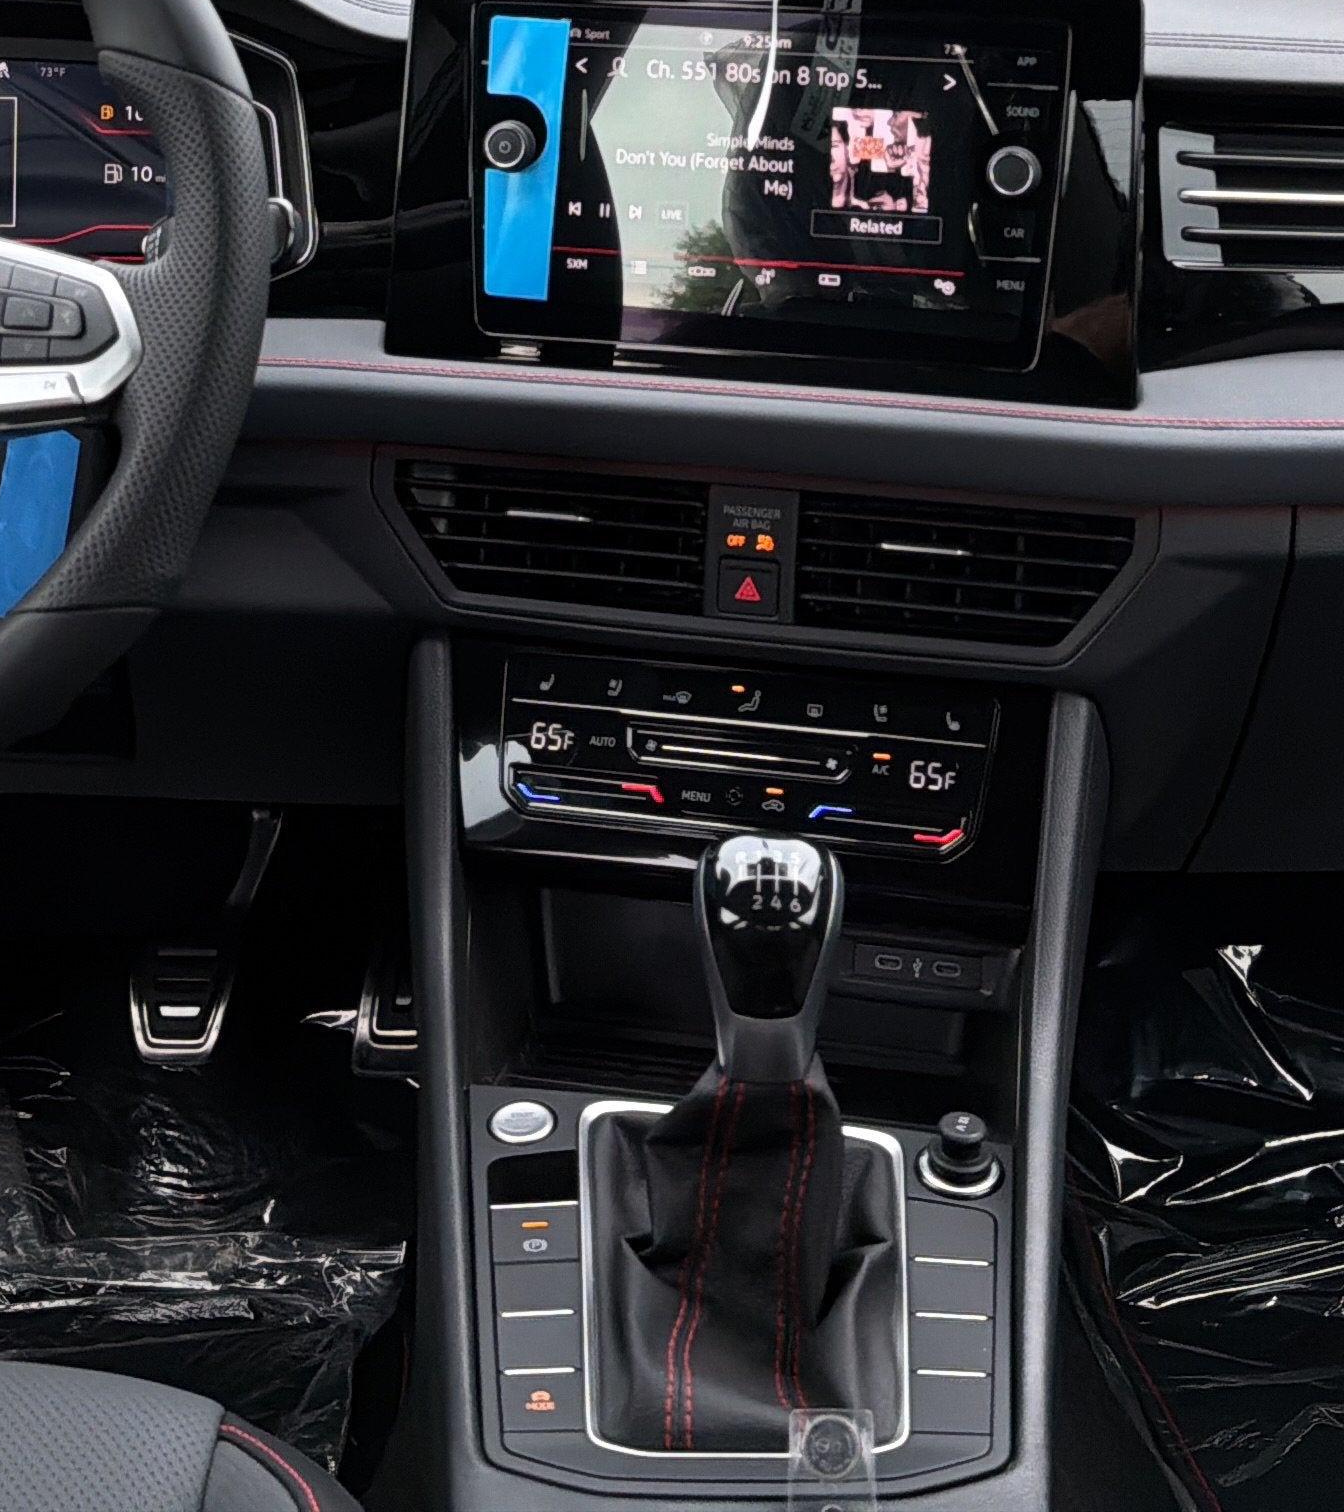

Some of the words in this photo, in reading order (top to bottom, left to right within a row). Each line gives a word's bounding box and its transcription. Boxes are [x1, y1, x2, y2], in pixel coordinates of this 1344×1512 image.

[585, 28, 610, 42] Sport
[742, 34, 792, 50] 9:25m
[1017, 56, 1038, 67] APP
[40, 66, 67, 78] 73°F
[646, 62, 675, 81] Ch.
[681, 59, 718, 81] 551
[725, 61, 761, 83] 80s
[797, 65, 811, 86] 8
[815, 66, 850, 90] Top
[1006, 105, 1041, 119] SOUND
[754, 135, 796, 152] Minds
[615, 148, 655, 166] Don't
[659, 152, 686, 167] You
[689, 152, 746, 173] (Forget
[748, 156, 795, 175] About
[130, 166, 153, 183] 10
[763, 180, 794, 201] Me)
[661, 209, 683, 222] LIVE
[849, 217, 903, 237] Related
[1003, 227, 1025, 239] CAR
[565, 257, 589, 271] SXM
[996, 279, 1026, 292] MENU
[723, 505, 782, 520] PASSENGER
[732, 518, 750, 529] AIR
[727, 534, 747, 547] OFF
[588, 734, 617, 748] AUTO
[871, 764, 891, 777] A/C
[680, 788, 712, 804] MENU
[751, 894, 764, 911] 2
[769, 893, 783, 910] 4
[789, 898, 803, 913] 6
